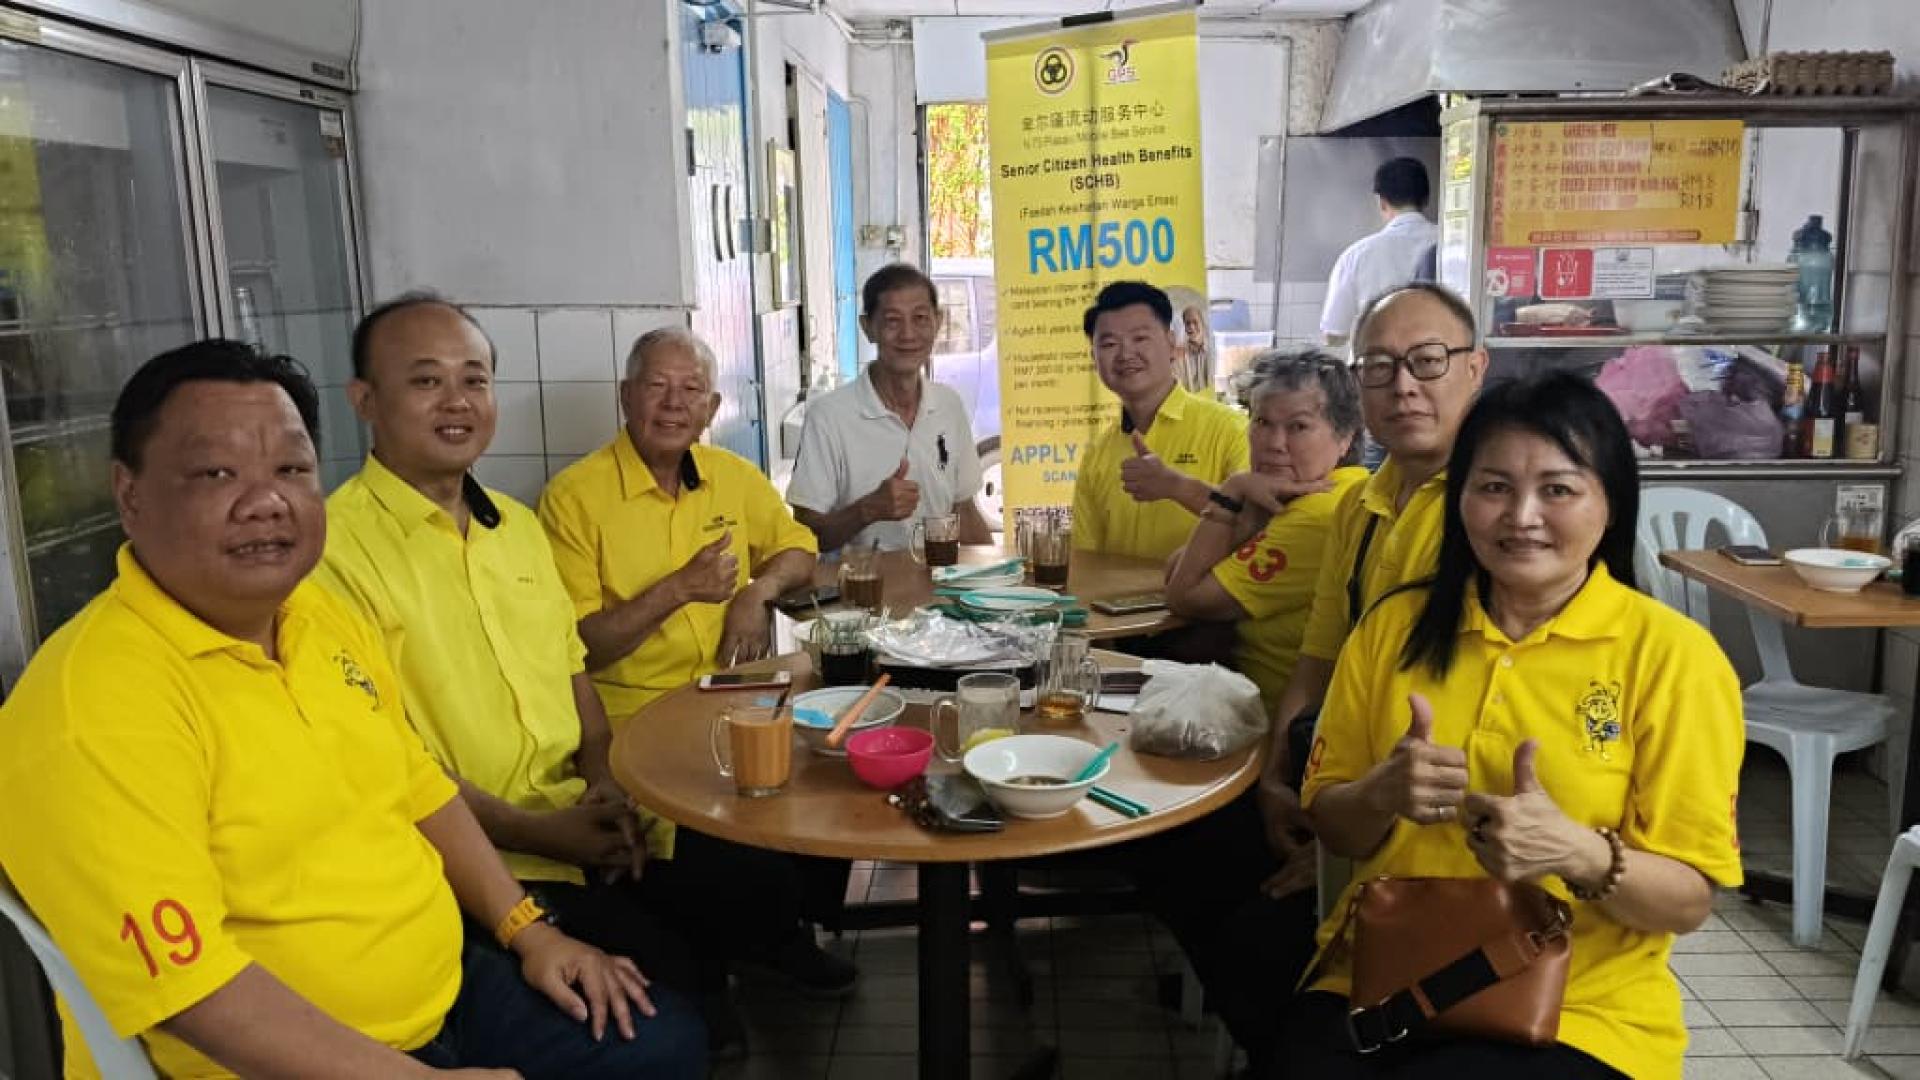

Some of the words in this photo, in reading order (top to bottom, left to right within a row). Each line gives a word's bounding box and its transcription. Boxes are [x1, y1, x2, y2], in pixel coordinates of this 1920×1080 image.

[1107, 67, 1135, 81] GPS
[1000, 162, 1039, 179] Senior
[1043, 156, 1087, 173] Citizen
[1091, 150, 1135, 168] Health
[1139, 145, 1192, 163] Benefits
[1070, 174, 1120, 194] (SCHB)
[1111, 197, 1144, 211] Warga
[1027, 217, 1176, 275] RM500
[1010, 443, 1078, 467] APPLY
[1043, 469, 1078, 483] SCAN
[120, 897, 203, 978] 19
